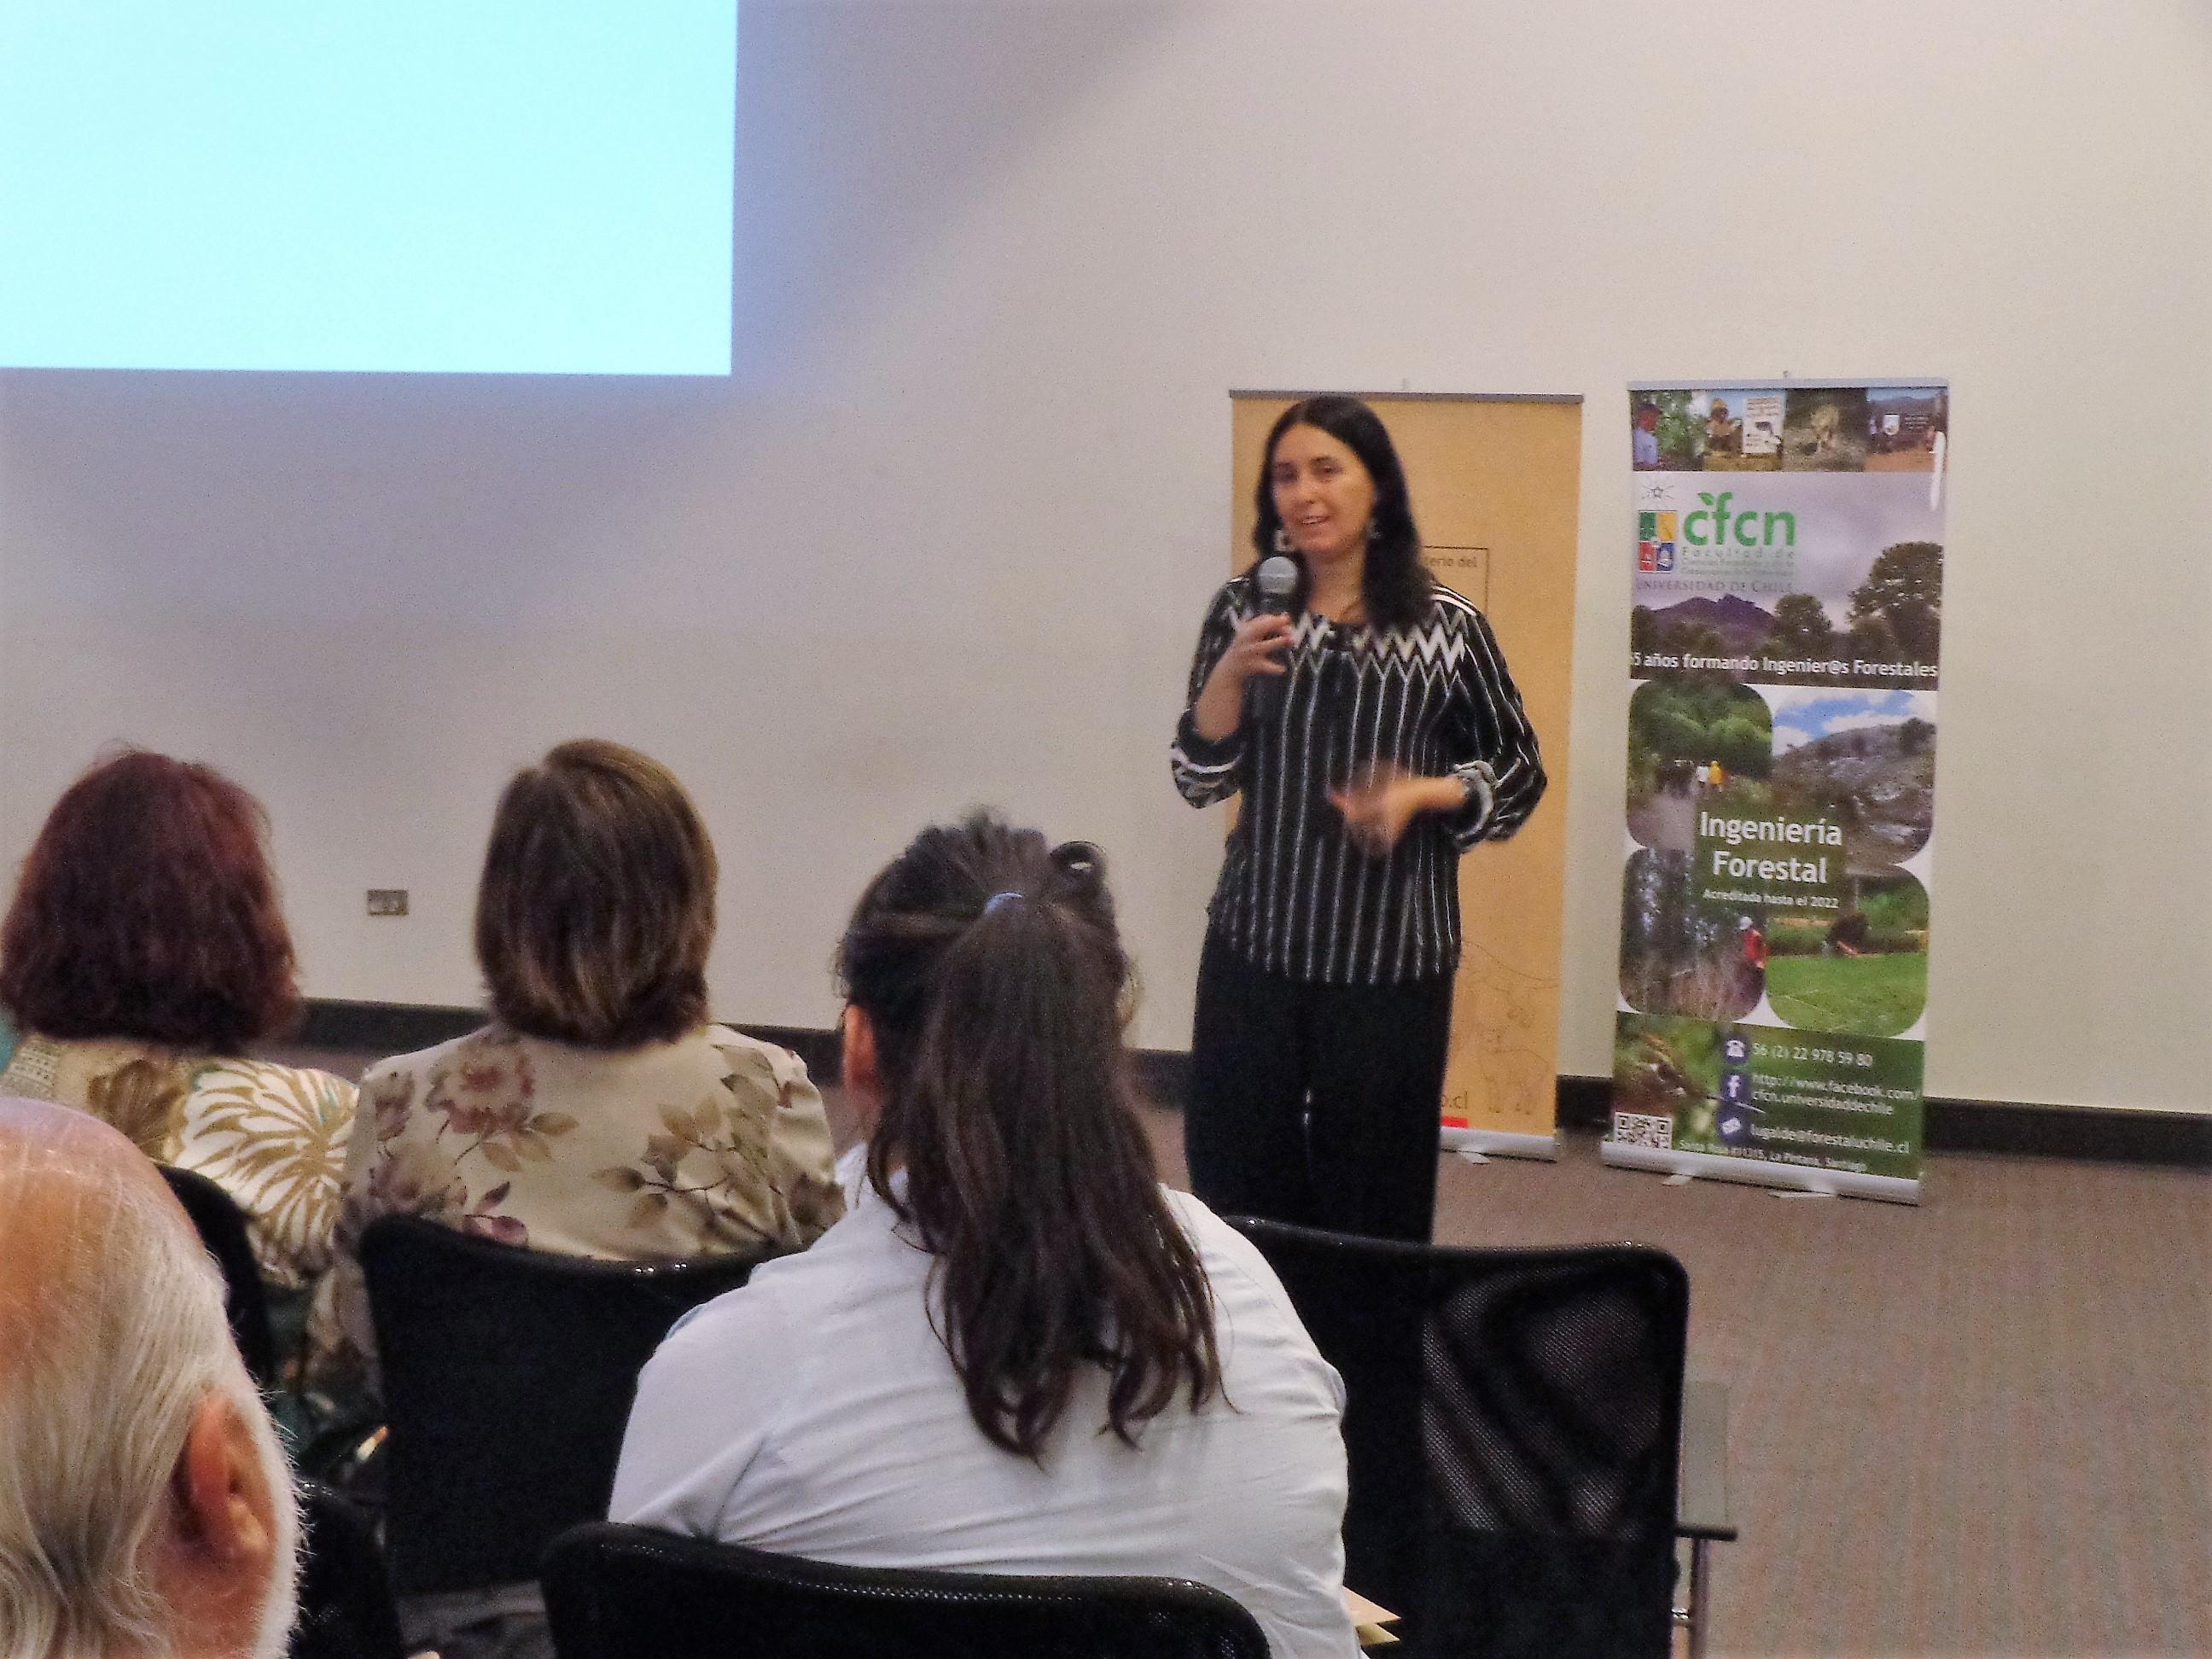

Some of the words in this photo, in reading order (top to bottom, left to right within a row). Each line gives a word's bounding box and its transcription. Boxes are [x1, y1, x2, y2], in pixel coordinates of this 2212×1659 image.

[1684, 492, 1796, 546] cfcn
[1644, 652, 1679, 668] años
[1682, 653, 1760, 671] formando
[1853, 659, 1938, 678] Forestales
[1700, 811, 1842, 847] Ingeniería
[1712, 850, 1829, 884] Forestal
[1793, 1046, 1808, 1061] 22
[1811, 1048, 1835, 1064] 978
